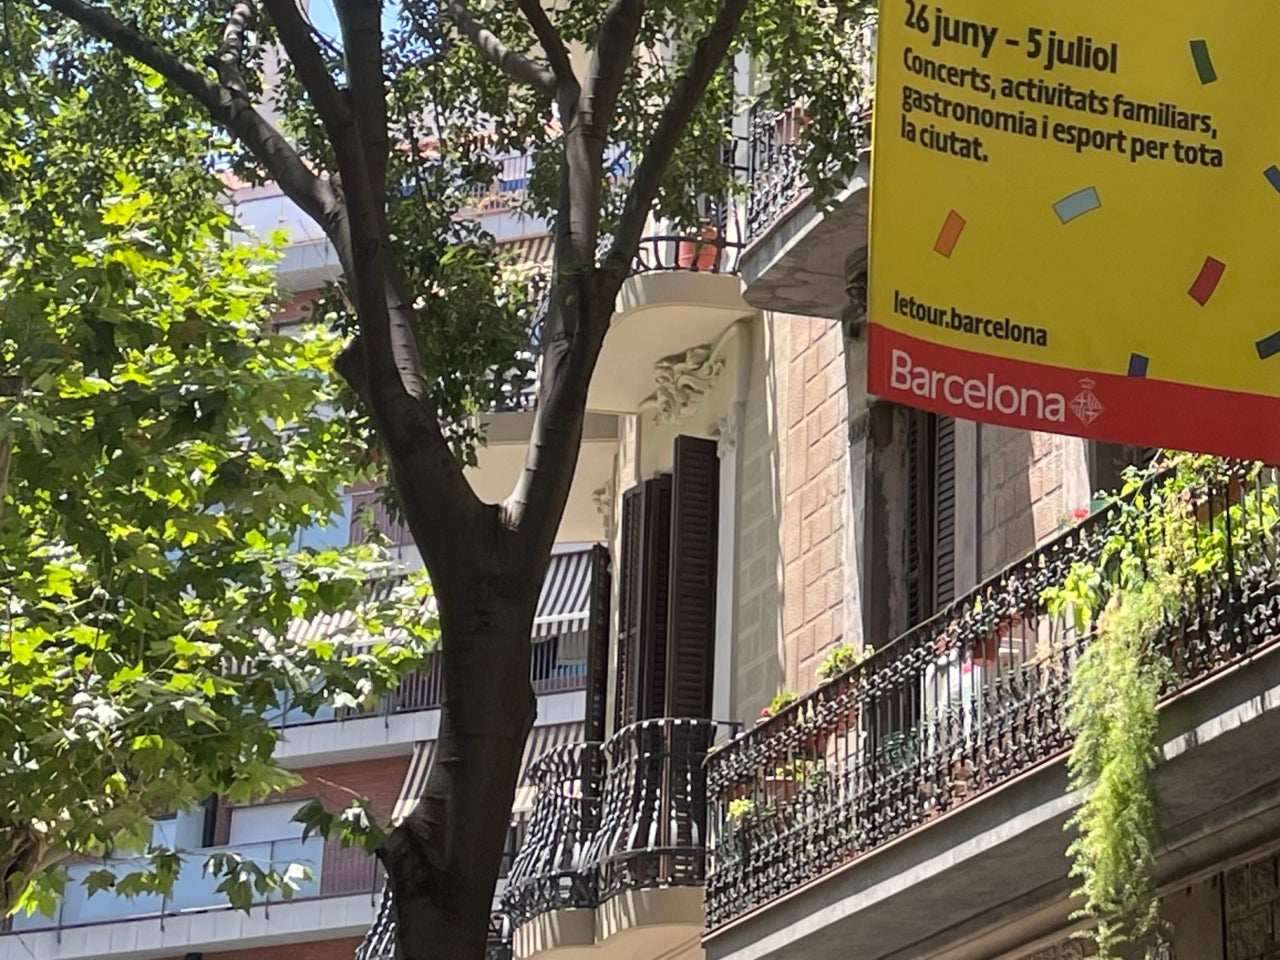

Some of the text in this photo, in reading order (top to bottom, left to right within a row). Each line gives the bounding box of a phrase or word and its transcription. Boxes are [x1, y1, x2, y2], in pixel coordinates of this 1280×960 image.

[932, 8, 998, 58] juny
[1027, 28, 1043, 60] 5
[1044, 30, 1118, 74] juliol
[902, 85, 1223, 168] gastronomia i esport per tota
[903, 46, 1218, 139] Concerts, activitats familiars,
[900, 113, 989, 162] la ciutat.
[893, 290, 1048, 347] letour.barcelona
[889, 348, 1066, 423] Barcelona
